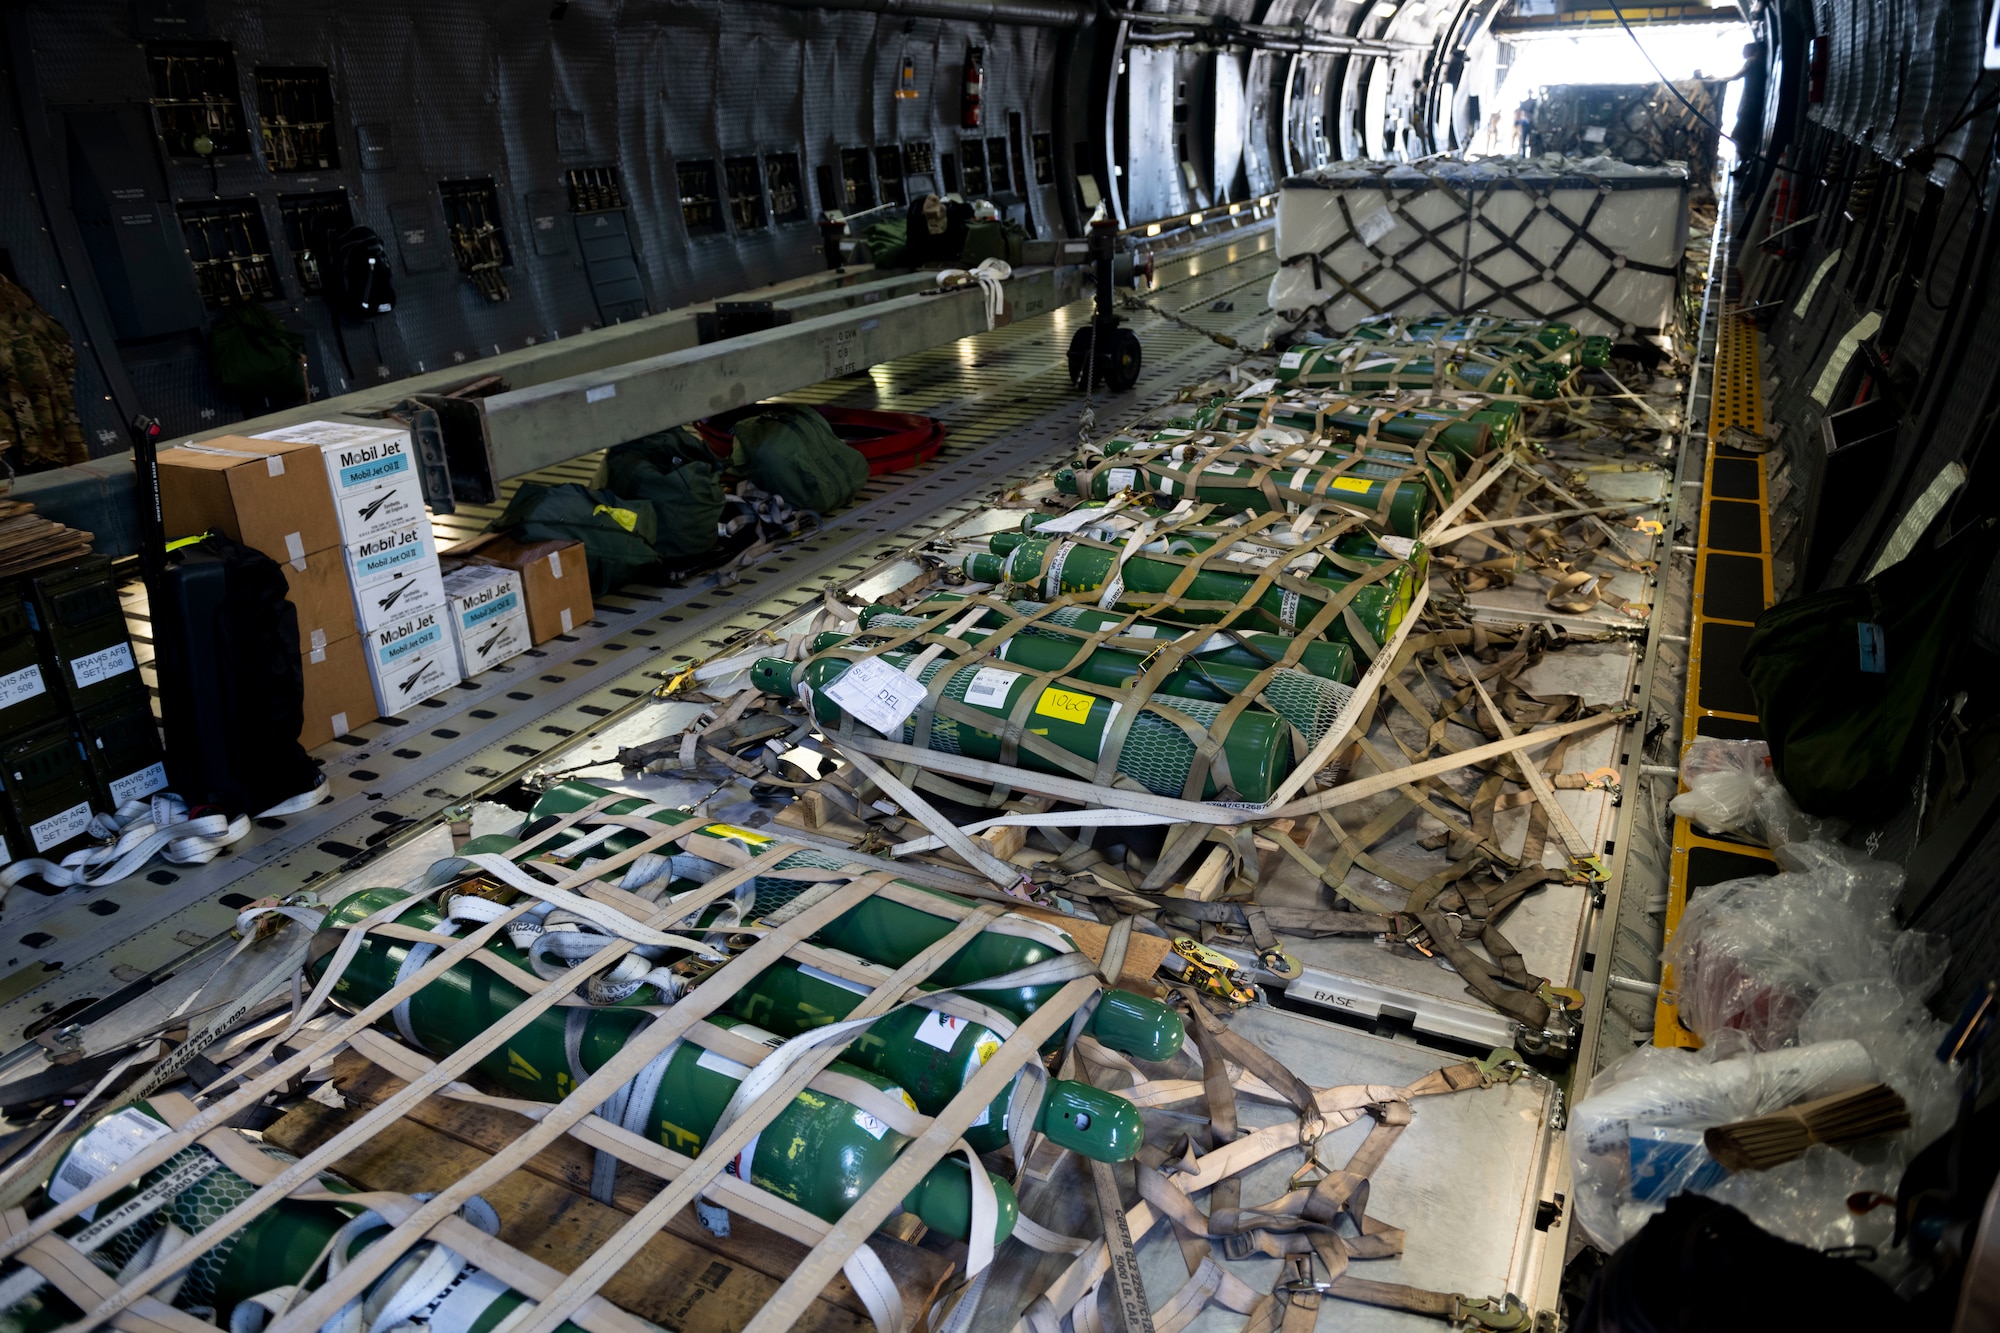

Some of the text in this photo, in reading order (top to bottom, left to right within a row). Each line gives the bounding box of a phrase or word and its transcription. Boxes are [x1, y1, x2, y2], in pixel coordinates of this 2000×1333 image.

[340, 442, 400, 468] Mobil Jet
[350, 470, 372, 482] Mobil
[372, 467, 383, 478] Jet
[384, 463, 393, 472] Oil
[360, 530, 418, 558] Mobil Jet
[368, 558, 388, 570] Mobil
[389, 555, 399, 564] Jet
[400, 552, 410, 560] Oil
[463, 582, 511, 610] Mobil Jet
[470, 610, 487, 622] Mobil
[488, 606, 497, 615] Jet
[380, 621, 414, 646] Mobil
[416, 614, 435, 630] Jet
[75, 646, 127, 670] TRAVIS AFB
[389, 644, 408, 657] Mobil
[408, 640, 418, 650] Jet
[419, 635, 428, 644] Oil
[19, 669, 37, 682] AFB
[83, 668, 102, 679] SET
[108, 659, 124, 670] 508
[18, 682, 34, 694] 508
[877, 689, 899, 710] DEL
[1052, 694, 1090, 712] 1060
[113, 765, 162, 792] TRAVIS AFB
[120, 787, 137, 800] SET
[144, 778, 158, 789] 508
[34, 816, 68, 835] TRAVIS
[70, 805, 88, 819] AFB
[42, 828, 61, 843] SET
[69, 818, 85, 830] 508
[1314, 990, 1356, 1008] BASE
[215, 1006, 246, 1036] CGU-1/B
[199, 1034, 213, 1051] CL2
[160, 1163, 216, 1200] 5000 LB.
[76, 1202, 142, 1243] CGU-1/B
[142, 1182, 172, 1202] CL2
[1115, 1209, 1132, 1248] CGU-1/B
[1126, 1251, 1137, 1270] CL2
[1115, 1254, 1138, 1326] 5000 LB. CAP.
